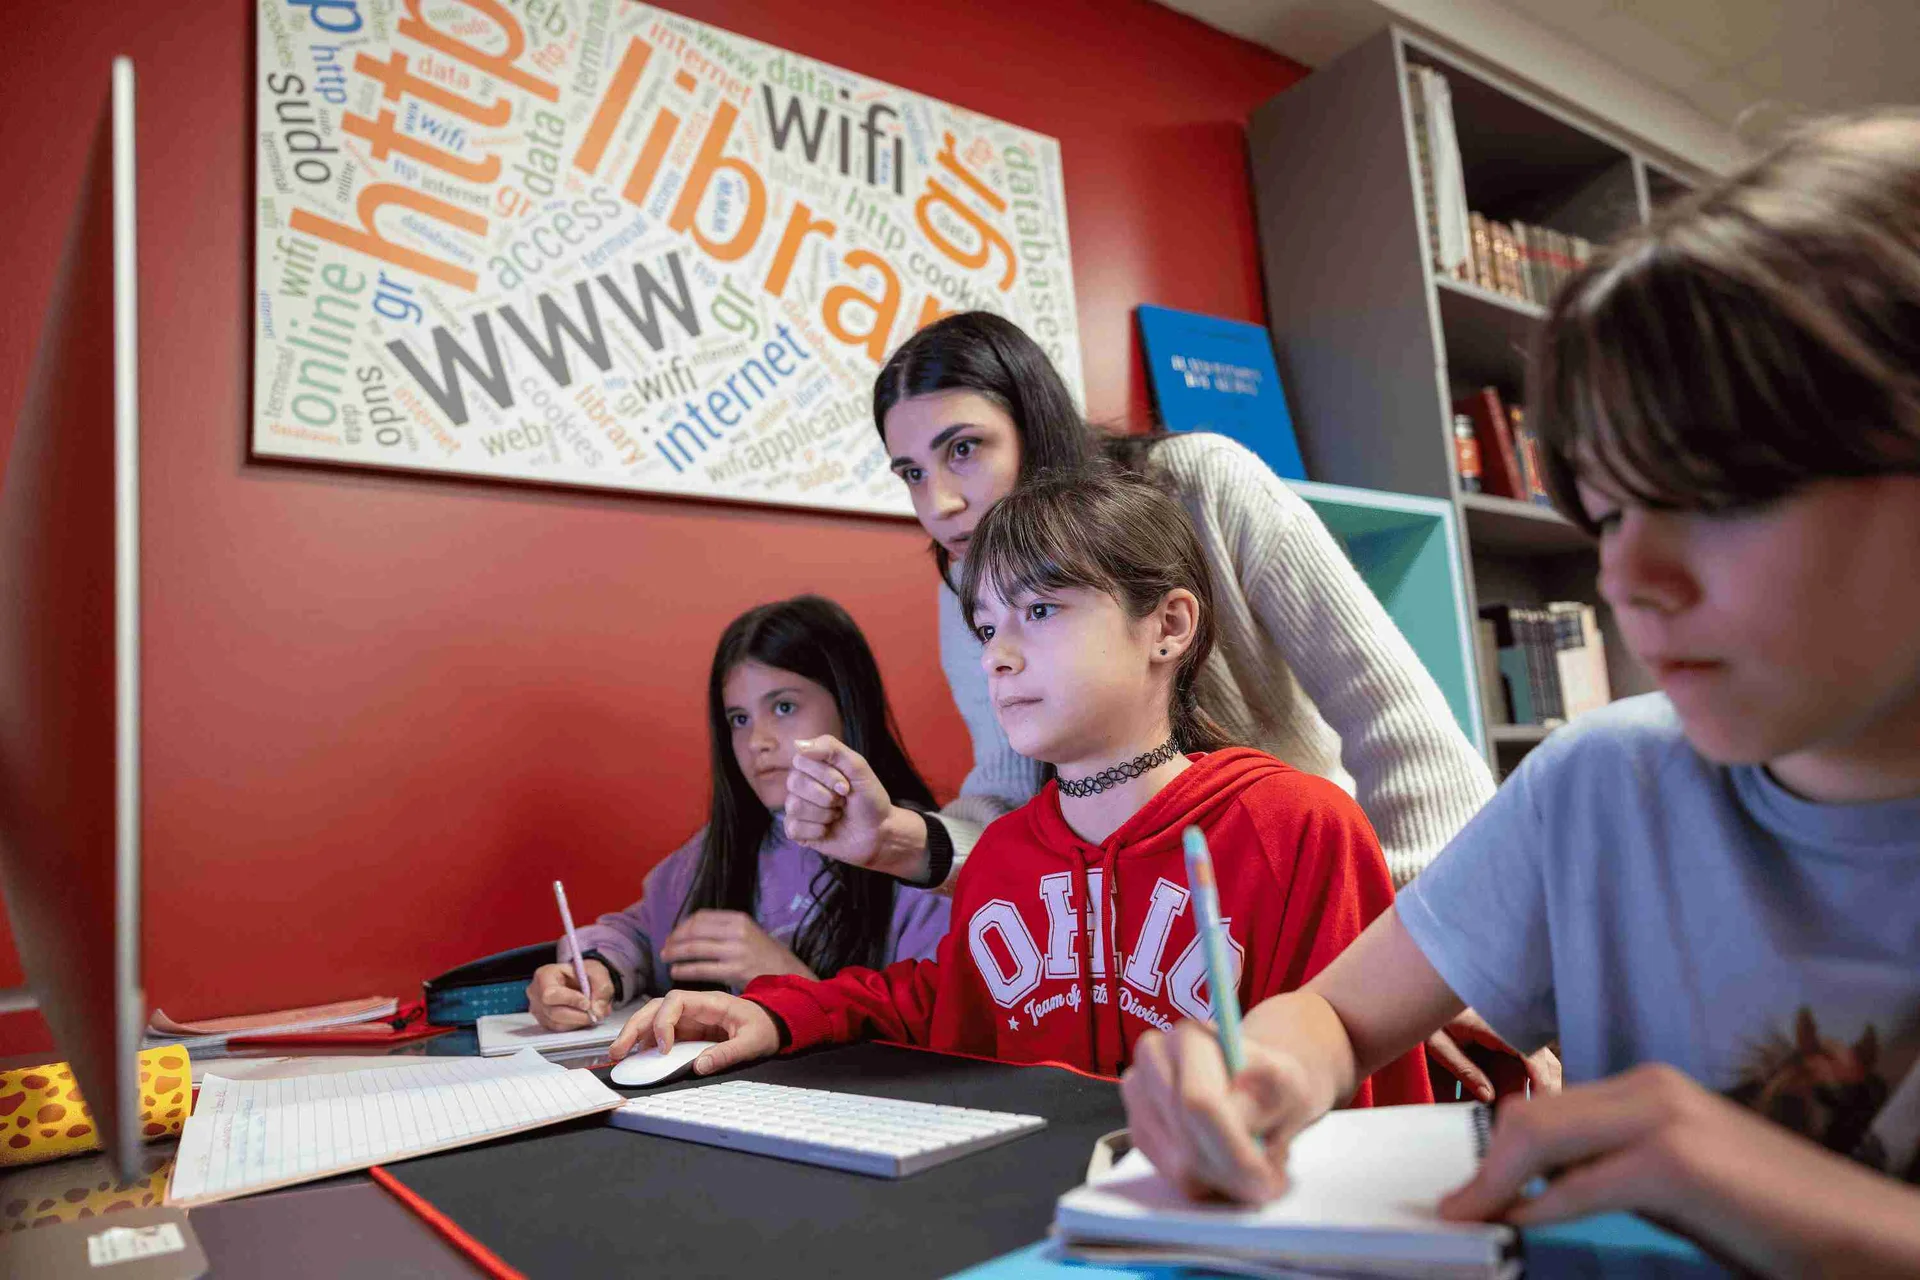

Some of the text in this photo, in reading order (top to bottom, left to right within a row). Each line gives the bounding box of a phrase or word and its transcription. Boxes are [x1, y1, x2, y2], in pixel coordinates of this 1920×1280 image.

[508, 0, 567, 37] eb
[571, 0, 611, 98] termina
[309, 44, 347, 105] http
[417, 55, 471, 91] data
[649, 22, 753, 108] internet
[767, 54, 834, 105] data
[267, 71, 338, 184] sudo
[288, 0, 559, 293] http
[420, 112, 466, 152] wifi
[510, 109, 567, 197] data
[762, 81, 904, 196] wifi
[421, 176, 490, 205] internet
[496, 185, 531, 219] gr
[573, 35, 957, 366] libra
[844, 186, 907, 251] http
[914, 130, 1017, 292] gr
[273, 236, 319, 298] wifi
[487, 186, 622, 290] access
[371, 269, 423, 327] gr
[711, 273, 759, 341] gr
[909, 250, 995, 312] cooki
[285, 262, 366, 427] online
[385, 250, 702, 427] www
[634, 355, 699, 402] wifi
[356, 365, 407, 447] sudo
[479, 418, 543, 457] web
[520, 376, 604, 468] cookies
[574, 384, 648, 466] library
[643, 321, 810, 473] internet
[743, 388, 872, 472] applicatio
[968, 867, 1245, 1022] OHIO
[1024, 992, 1065, 1027] Team
[1118, 986, 1174, 1033] Divisio
